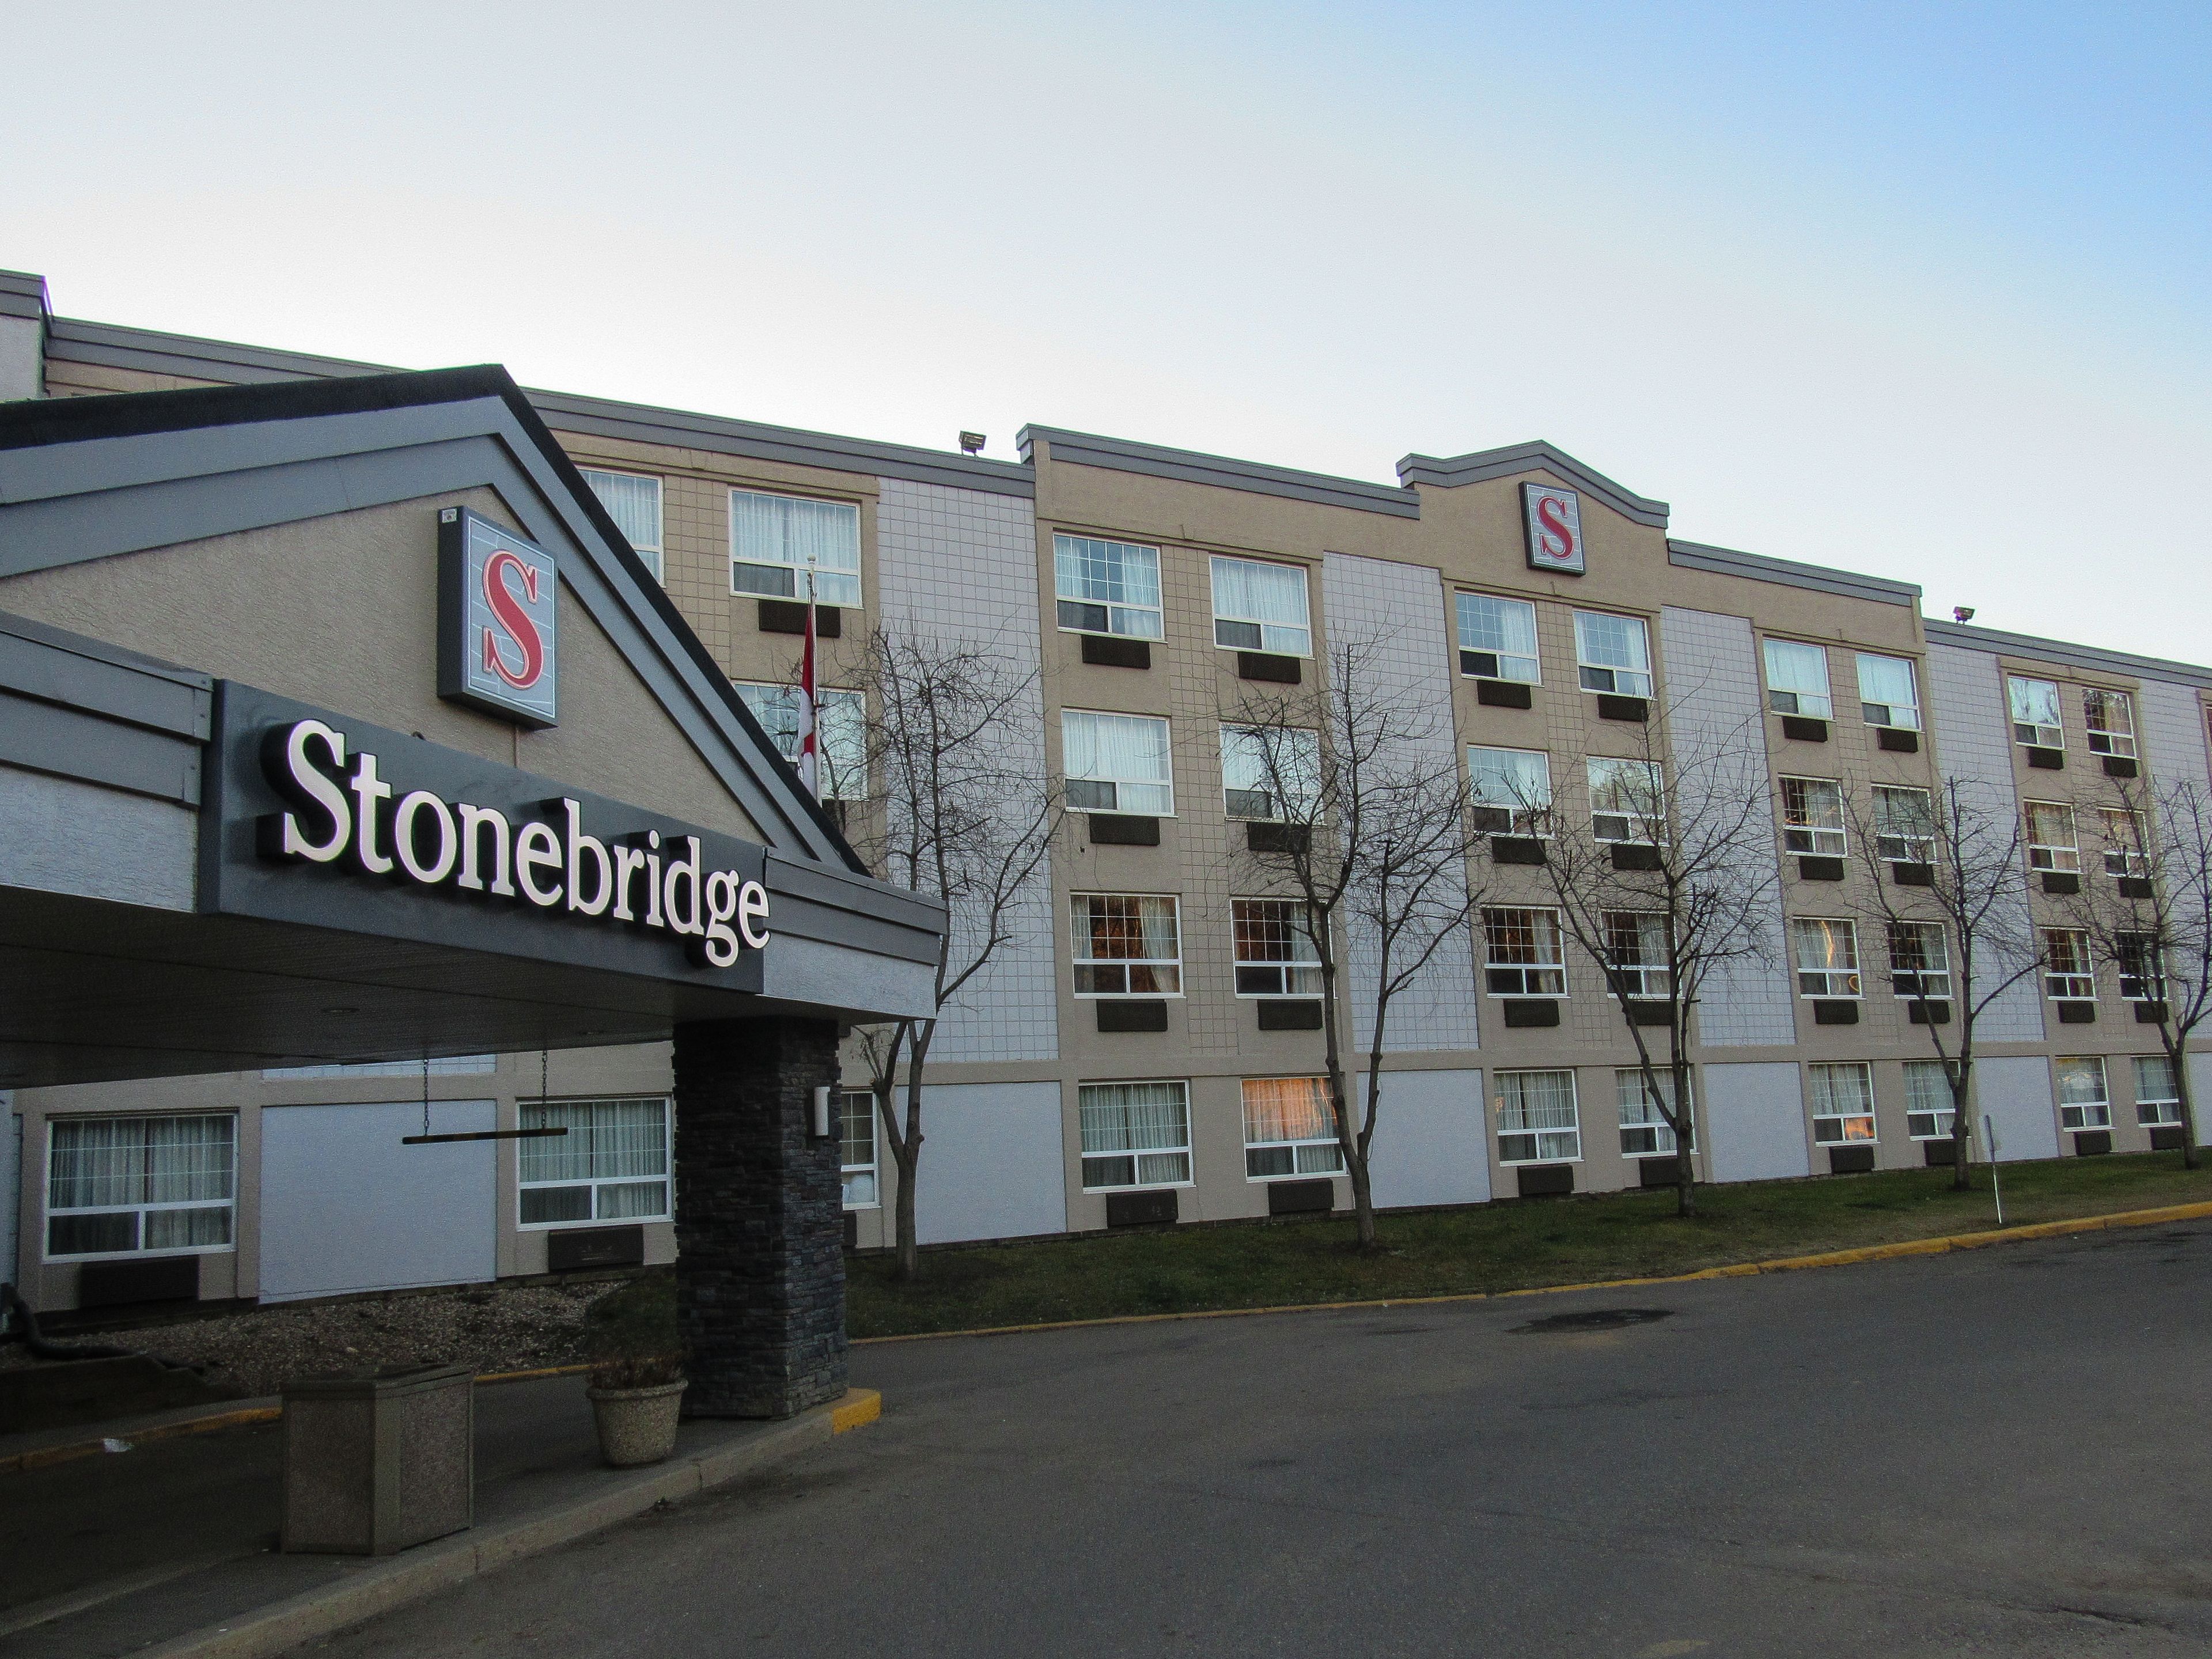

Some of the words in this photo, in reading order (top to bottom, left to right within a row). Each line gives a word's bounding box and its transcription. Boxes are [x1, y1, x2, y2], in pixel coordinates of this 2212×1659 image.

[1537, 495, 1574, 559] S
[482, 549, 543, 689] S
[283, 718, 770, 968] Stonebridge
